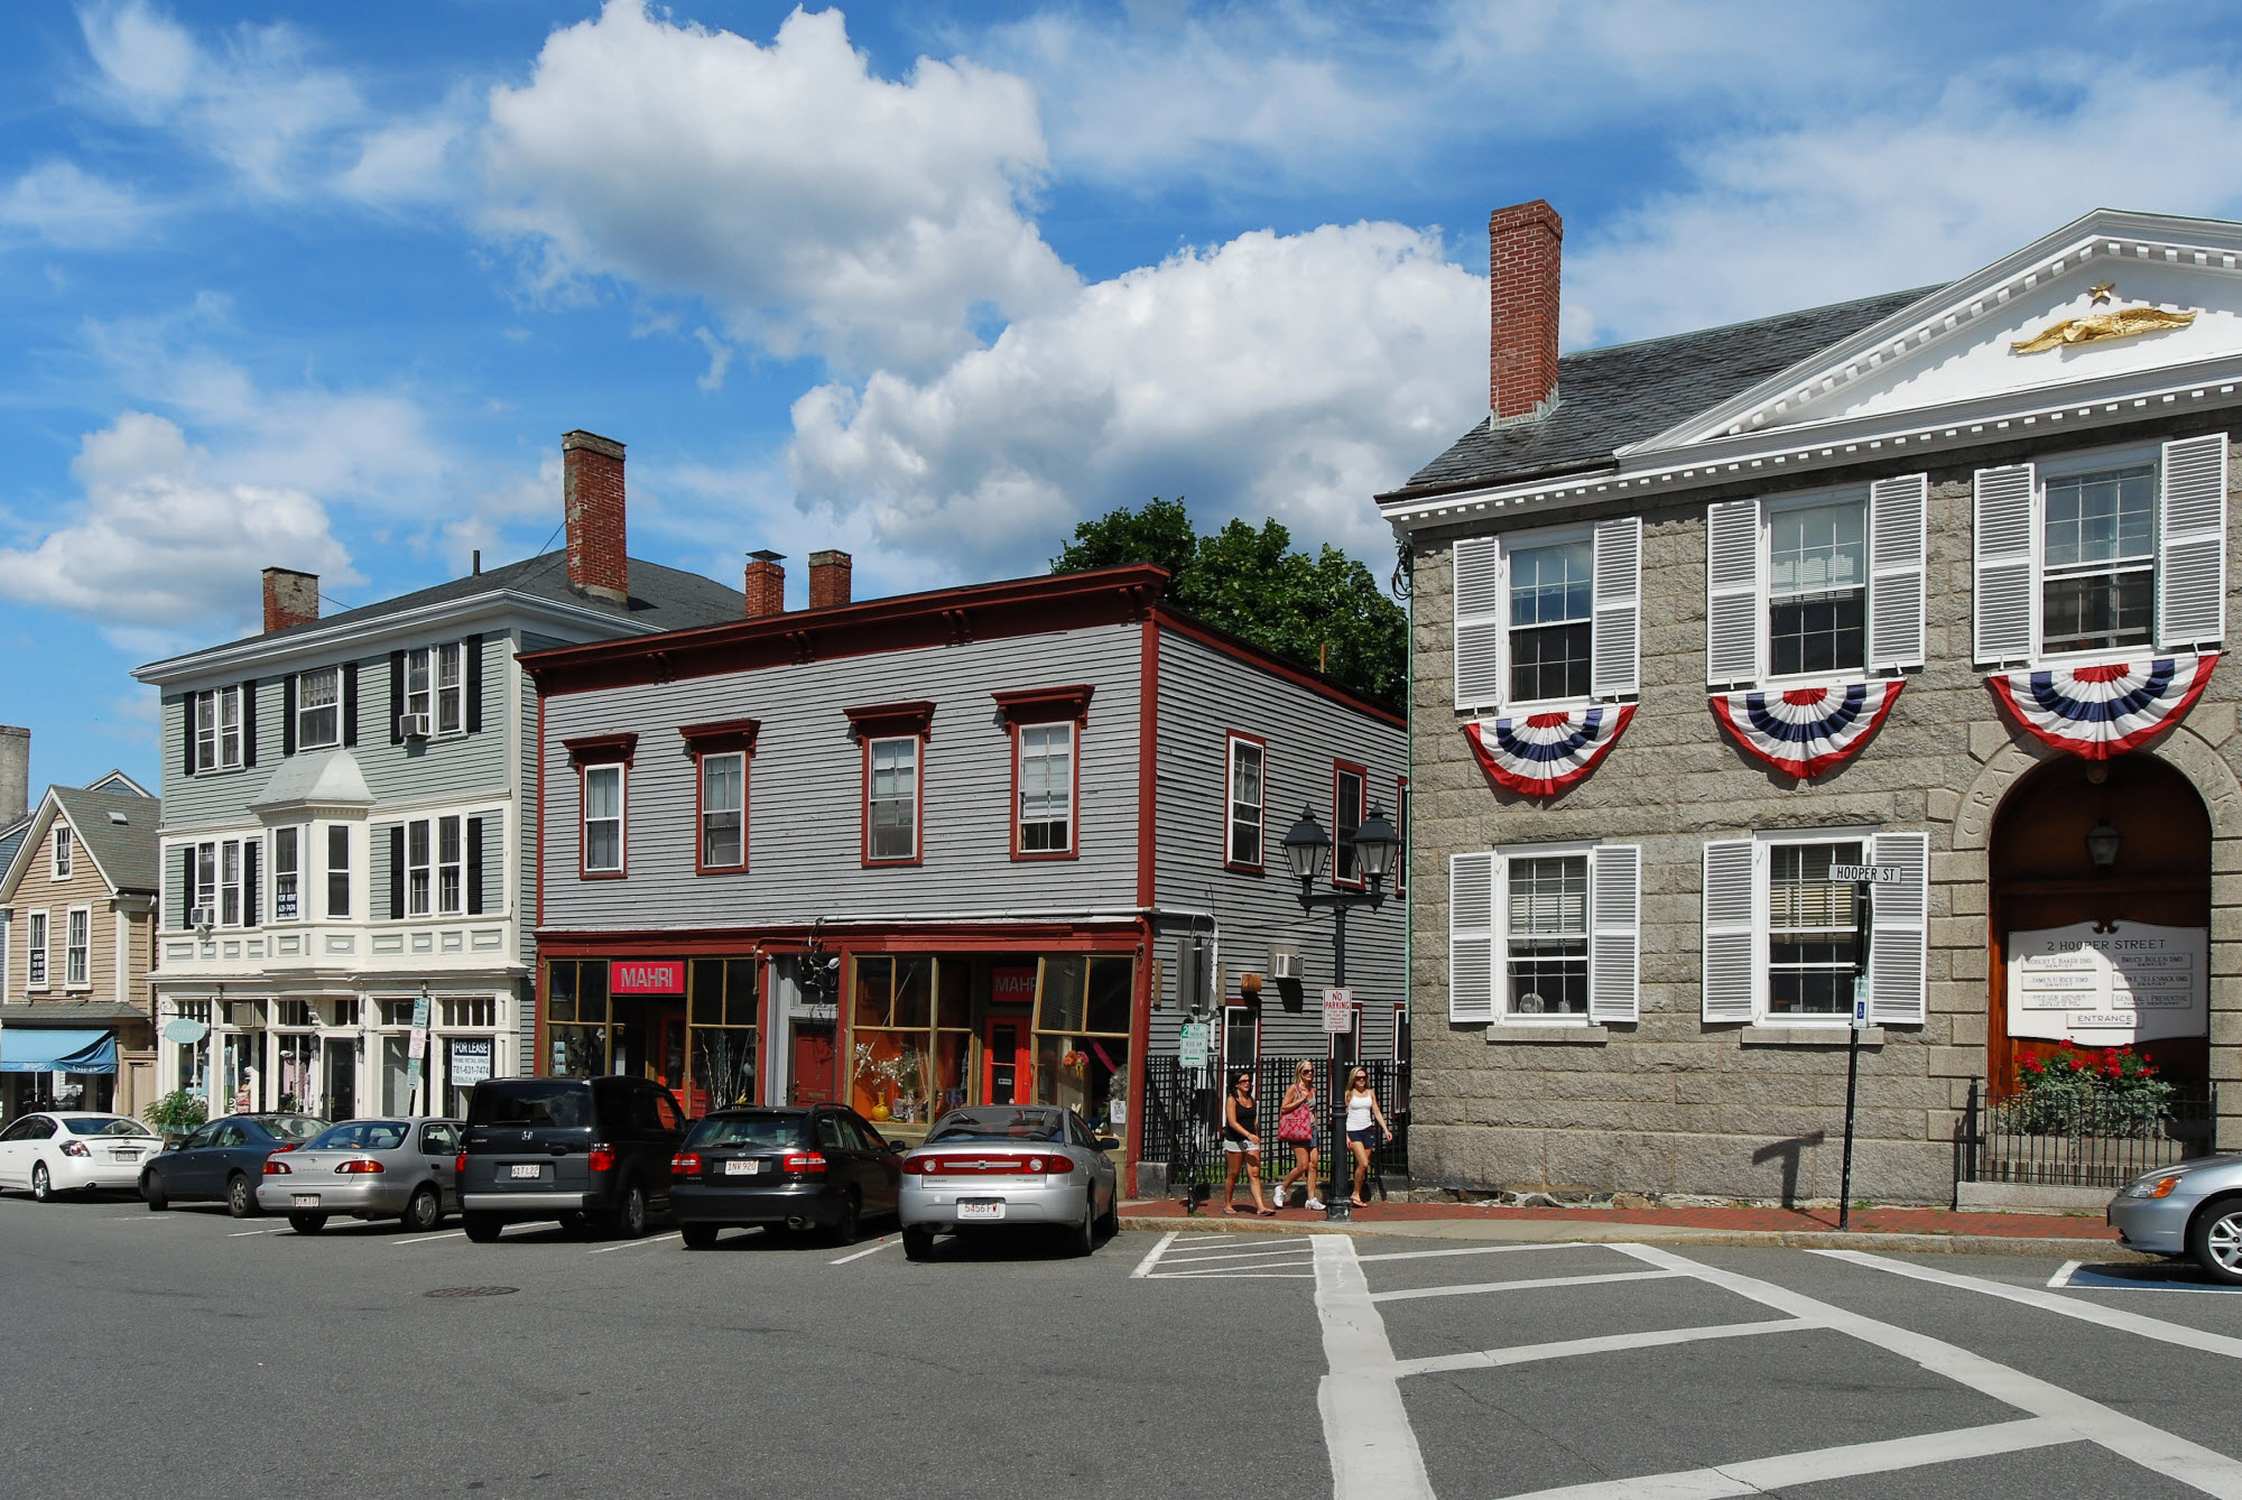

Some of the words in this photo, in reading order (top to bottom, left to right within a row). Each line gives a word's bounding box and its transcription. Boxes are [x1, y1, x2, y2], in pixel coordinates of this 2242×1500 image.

[1837, 866, 1878, 880] HOOPER
[1883, 868, 1895, 881] ST
[2047, 941, 2055, 951] 2
[2114, 939, 2166, 950] STREET
[621, 967, 673, 987] MAHRI
[994, 976, 1036, 993] MAHR
[1332, 991, 1343, 1001] NO
[1325, 1001, 1350, 1010] PARKING
[455, 1041, 468, 1053] FOR
[468, 1041, 488, 1054] LEASE
